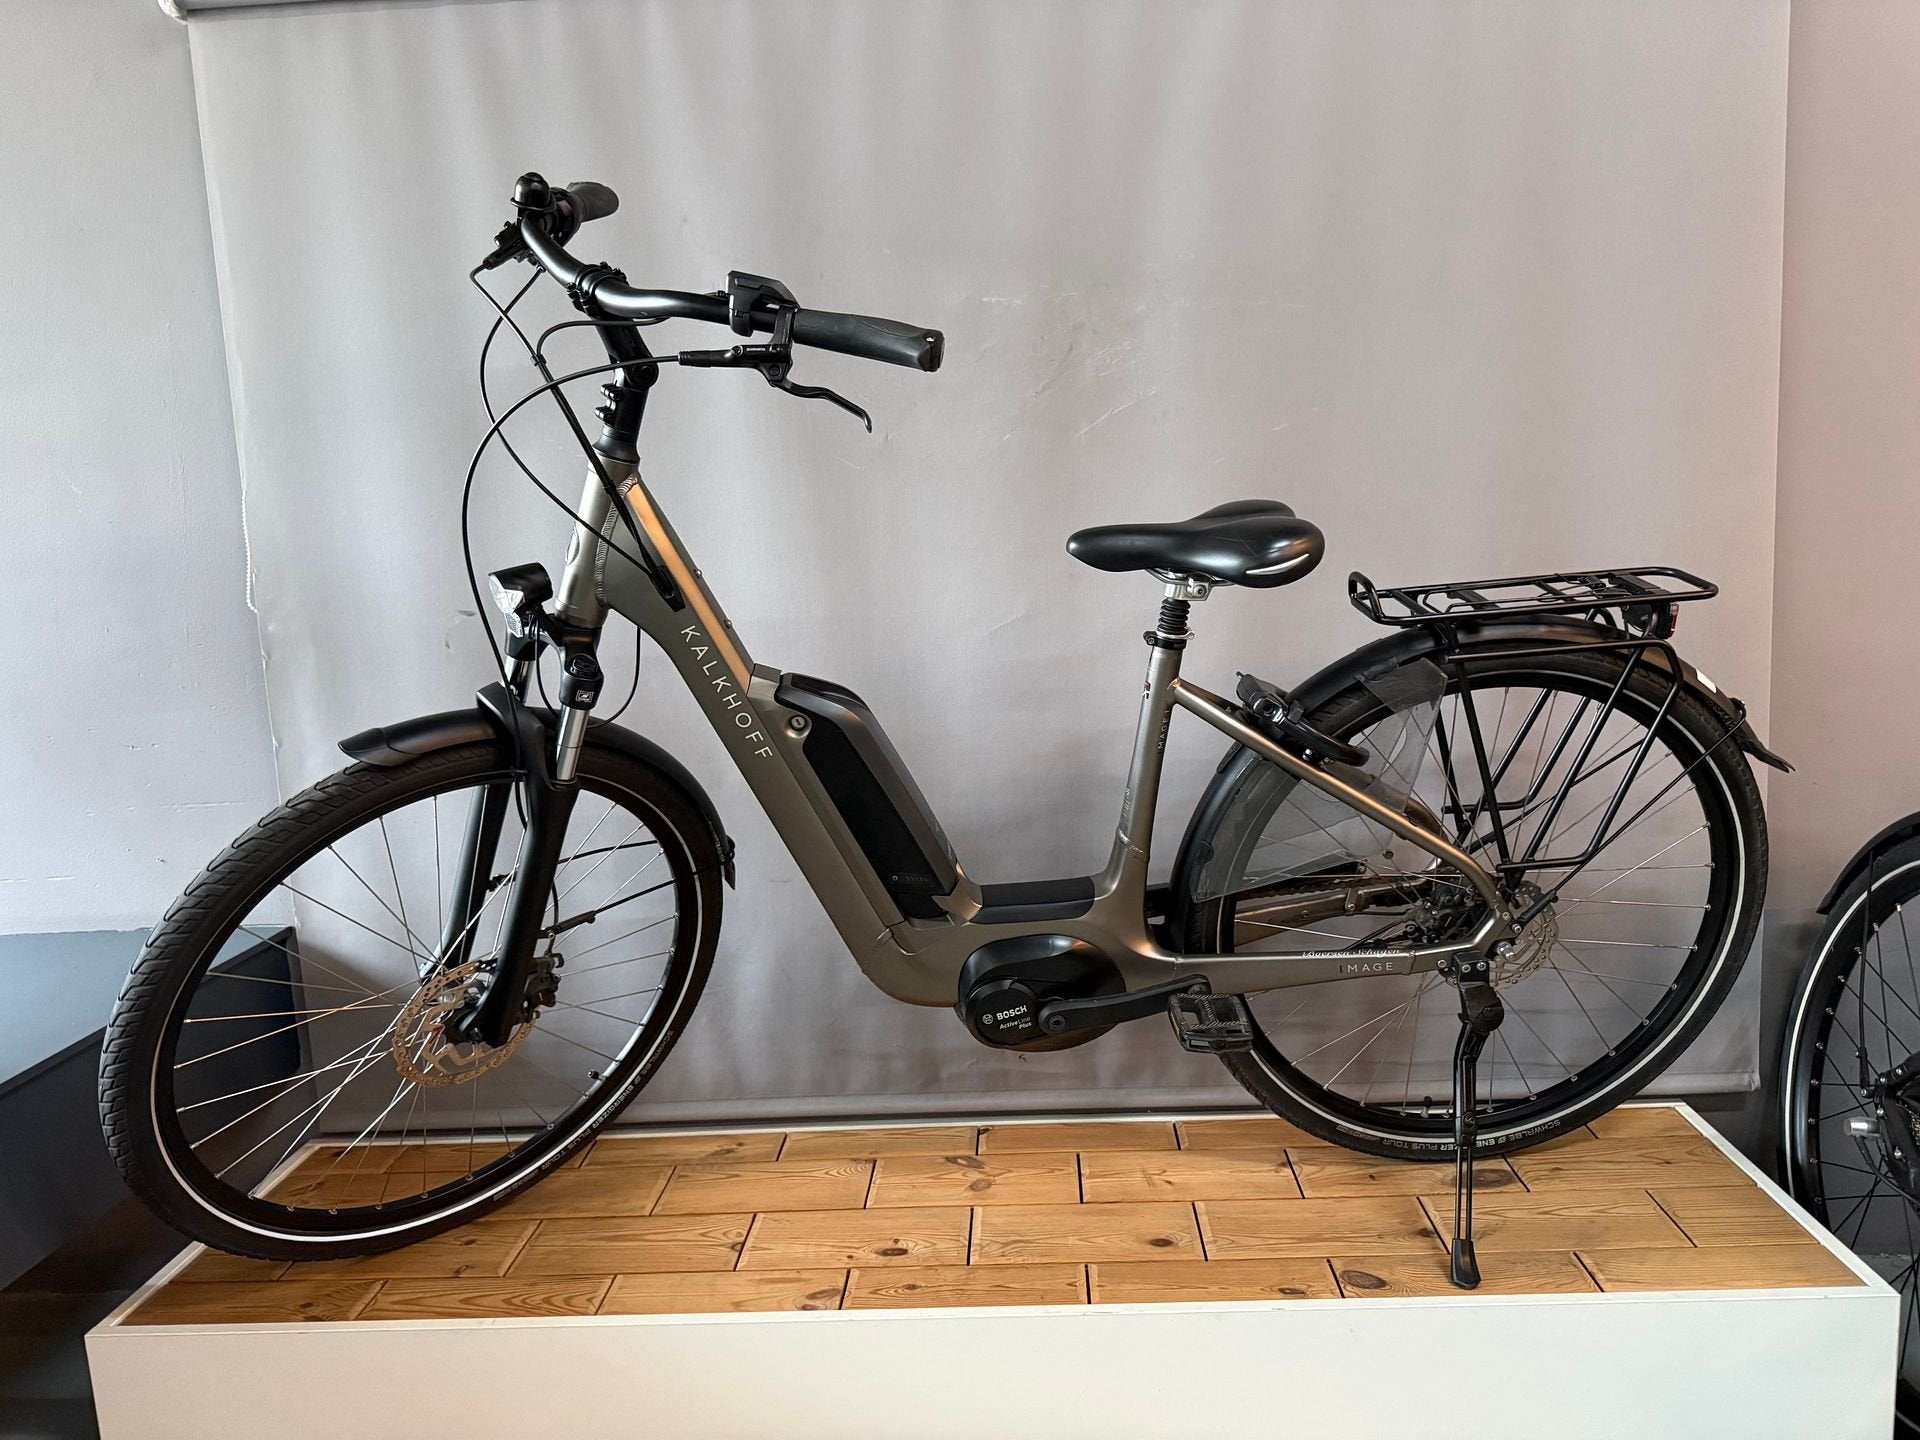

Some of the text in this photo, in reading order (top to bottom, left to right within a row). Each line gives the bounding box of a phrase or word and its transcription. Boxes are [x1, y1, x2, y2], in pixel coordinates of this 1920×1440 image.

[680, 625, 773, 758] KALKHOFF
[996, 1005, 1028, 1020] BOSCH
[592, 1084, 635, 1129] ENERGIZER
[567, 1128, 592, 1150] PLUS
[1508, 1119, 1561, 1141] SCHWALBE
[1382, 1138, 1409, 1150] TOUR
[1411, 1142, 1438, 1151] PLUS
[541, 1149, 568, 1171] TOUR
